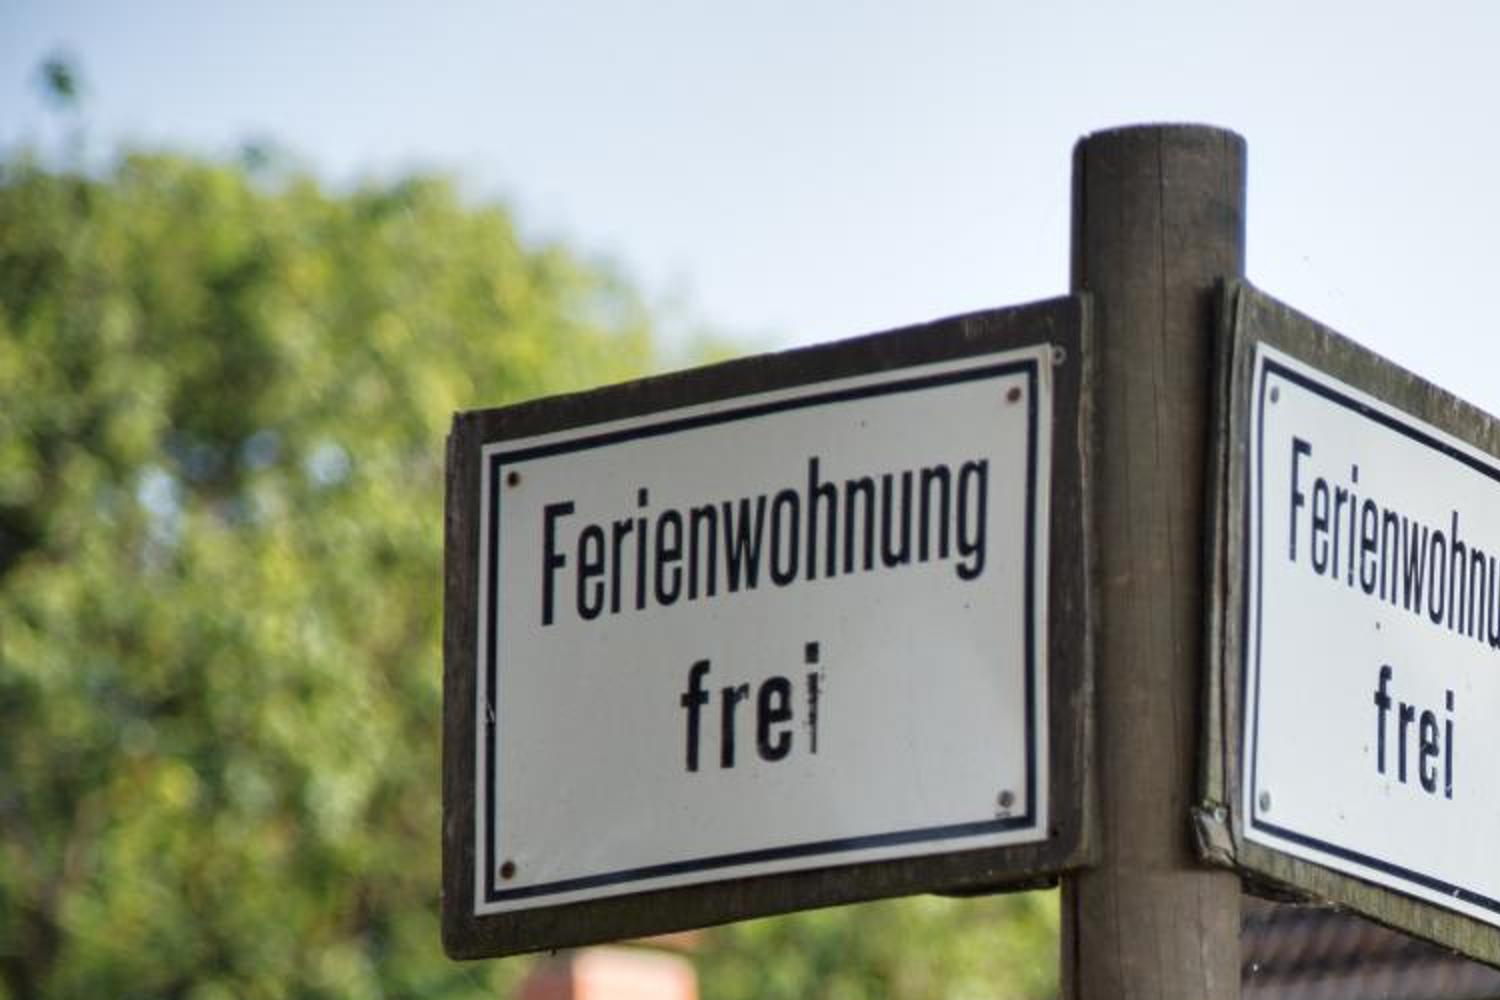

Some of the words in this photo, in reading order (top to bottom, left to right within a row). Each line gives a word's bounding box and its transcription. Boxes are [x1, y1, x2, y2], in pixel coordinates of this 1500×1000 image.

[541, 456, 988, 627] Ferienwohnung
[680, 642, 820, 773] frei
[1374, 665, 1454, 799] frei
